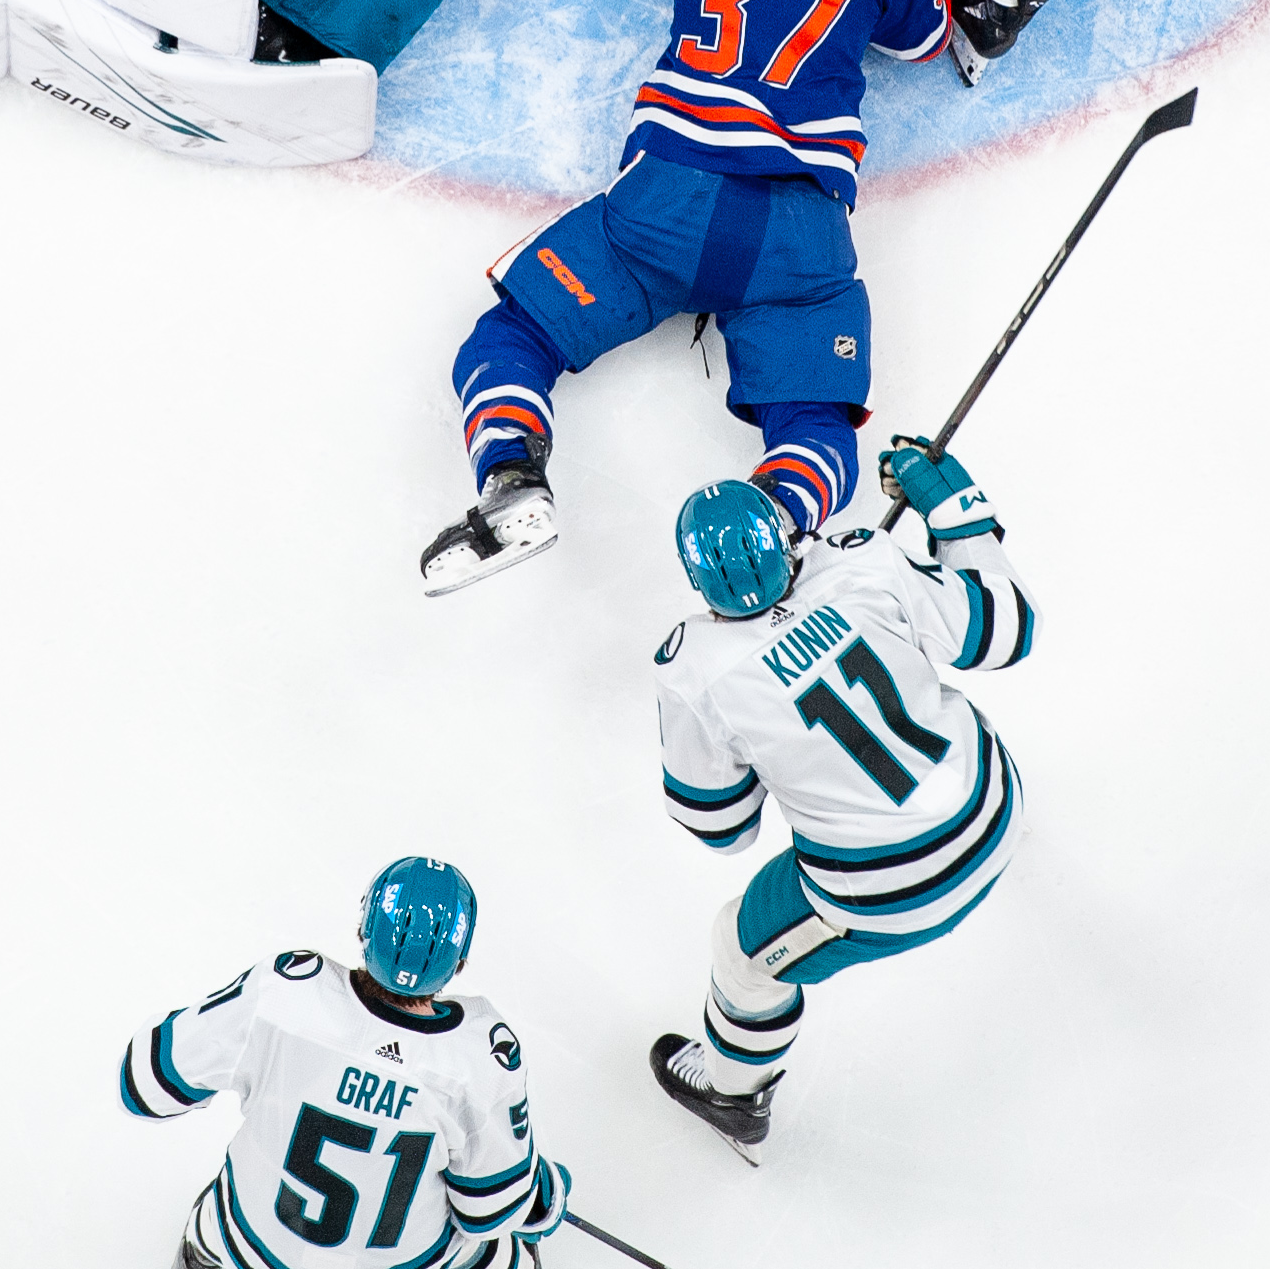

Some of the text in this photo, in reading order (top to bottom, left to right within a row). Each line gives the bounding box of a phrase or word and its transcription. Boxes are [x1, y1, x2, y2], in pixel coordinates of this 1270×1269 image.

[537, 247, 597, 307] CCM
[704, 485, 720, 500] 11
[684, 532, 702, 567] SAP
[755, 517, 775, 551] SAP
[742, 592, 759, 608] 11
[761, 605, 852, 688] KUNIN
[794, 635, 952, 807] 11
[381, 883, 400, 914] SAP
[452, 911, 468, 947] SAP
[765, 945, 790, 966] CCM
[396, 969, 418, 988] 51
[374, 1048, 404, 1065] adidas
[336, 1066, 419, 1120] GRAF
[274, 1102, 437, 1249] 51
